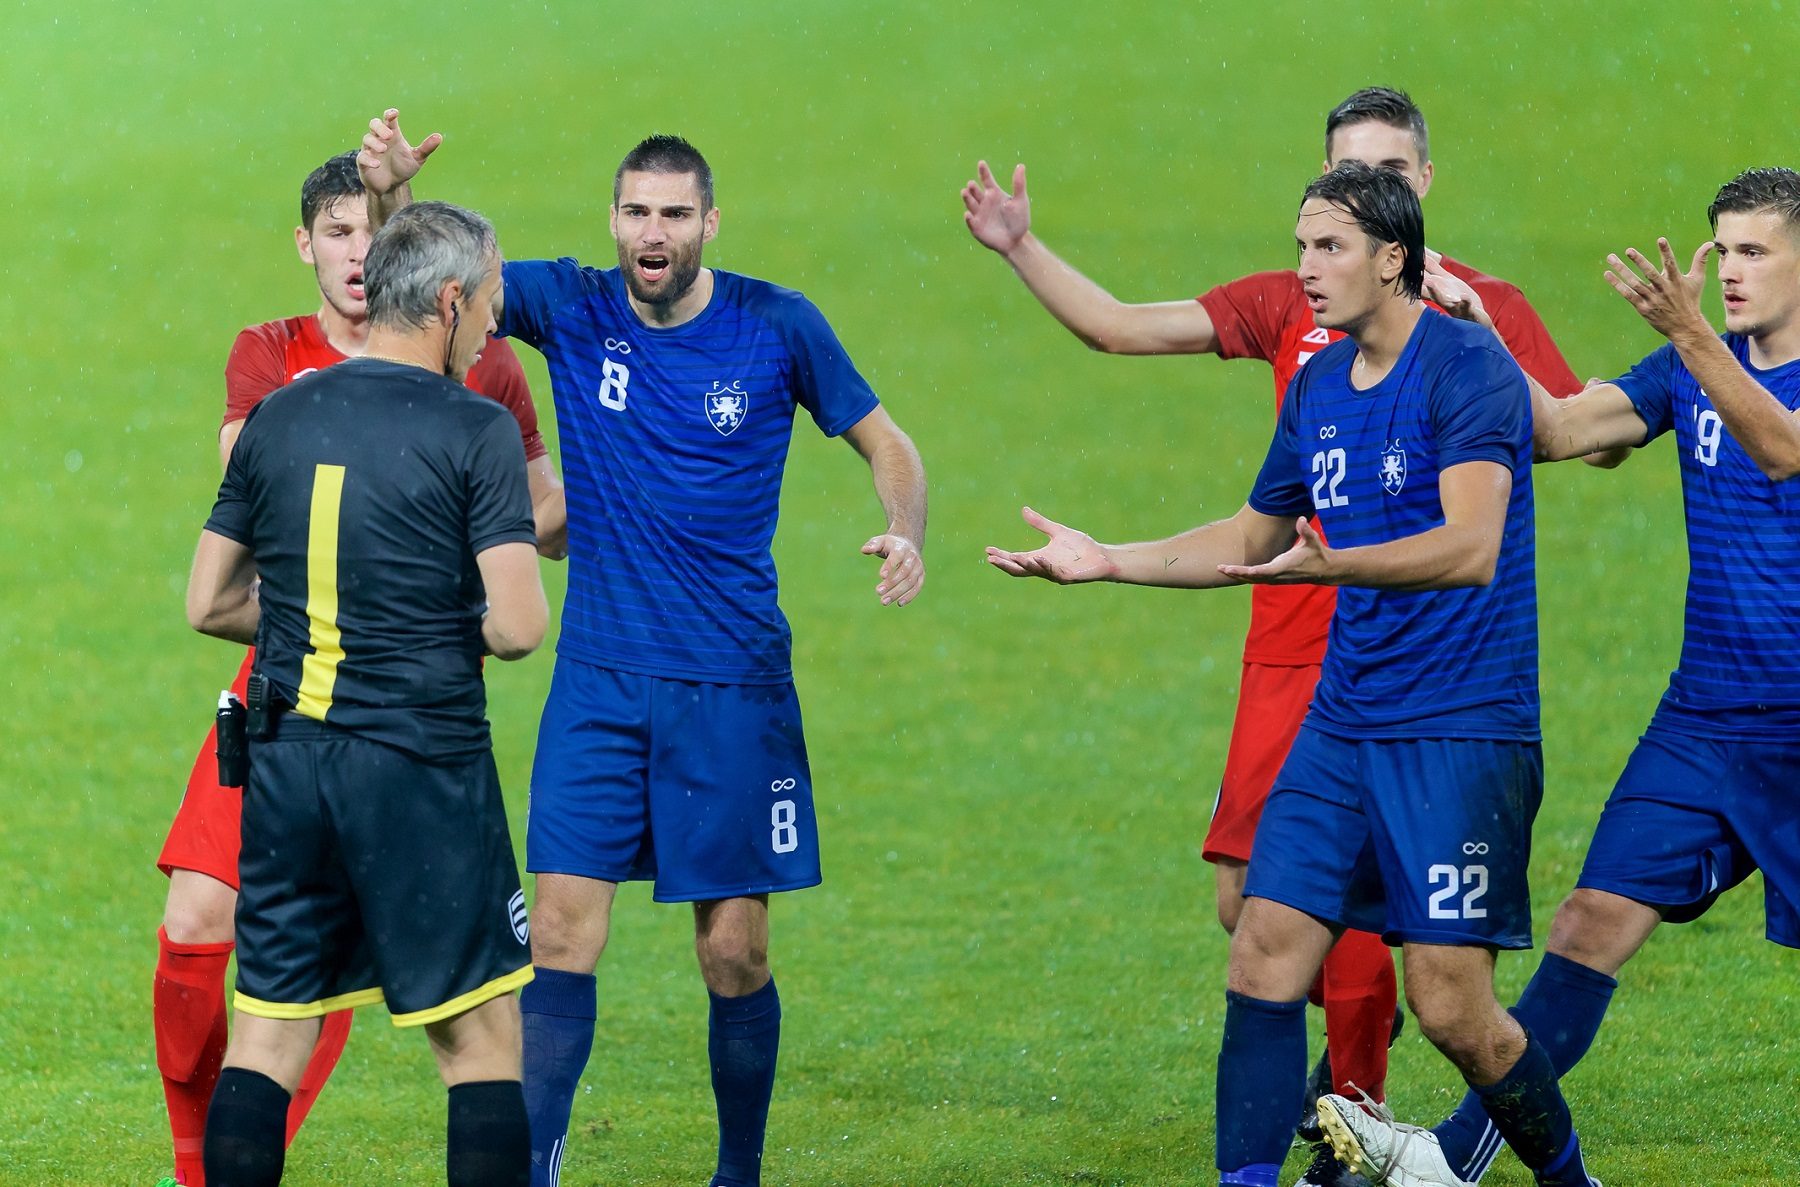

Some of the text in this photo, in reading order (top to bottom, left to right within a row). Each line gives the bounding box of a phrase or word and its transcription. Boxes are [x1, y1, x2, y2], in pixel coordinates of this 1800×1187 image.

[599, 357, 630, 412] 8
[713, 380, 741, 390] F C
[1312, 448, 1349, 510] 22
[771, 799, 798, 854] 8
[1428, 864, 1489, 919] 22
